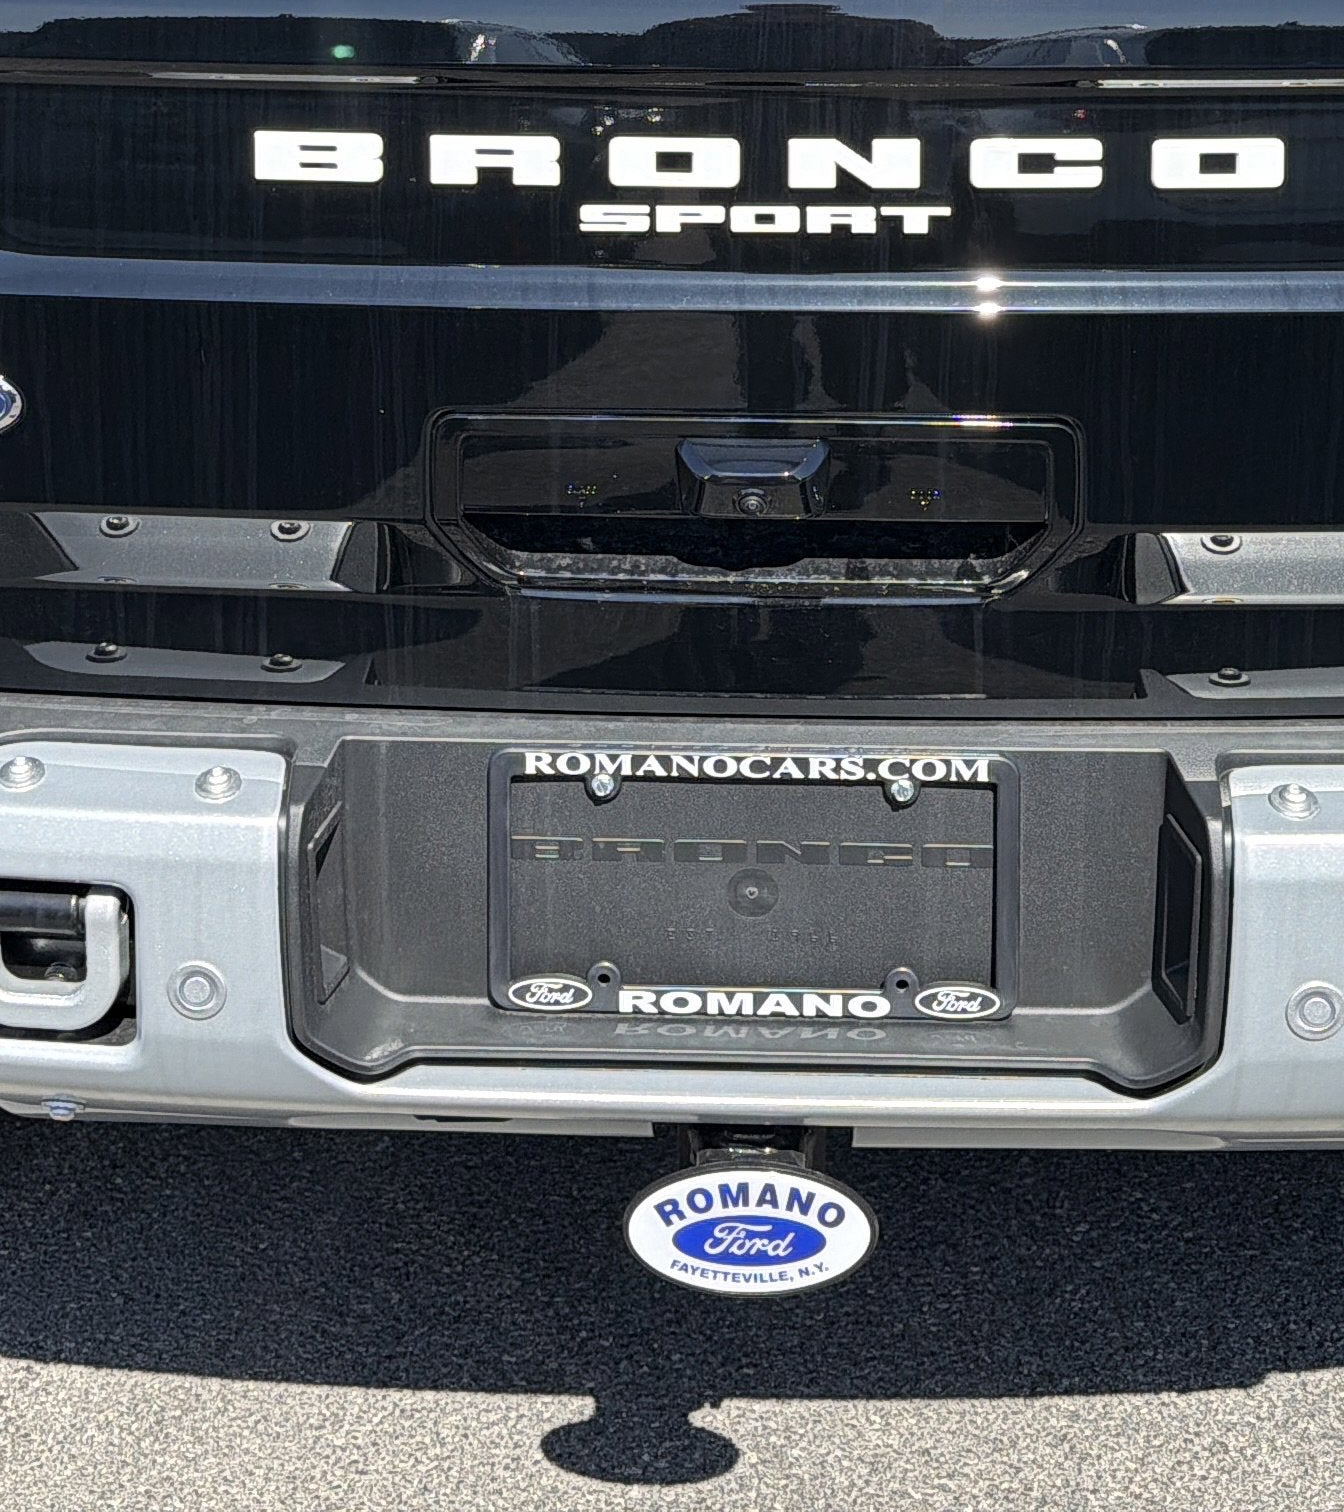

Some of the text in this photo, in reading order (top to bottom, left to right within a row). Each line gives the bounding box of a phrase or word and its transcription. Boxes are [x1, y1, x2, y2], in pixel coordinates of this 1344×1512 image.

[253, 129, 1285, 190] BRONCO
[578, 203, 952, 235] SPORT
[523, 751, 991, 783] ROMANOCARS.COM
[510, 835, 994, 868] BRONCO
[524, 982, 983, 1019] Ford ROMANO Ford
[652, 1181, 847, 1229] ROMANO
[703, 1221, 796, 1257] Ford
[669, 1258, 830, 1284] FAYETTEVILLE, N.Y.
